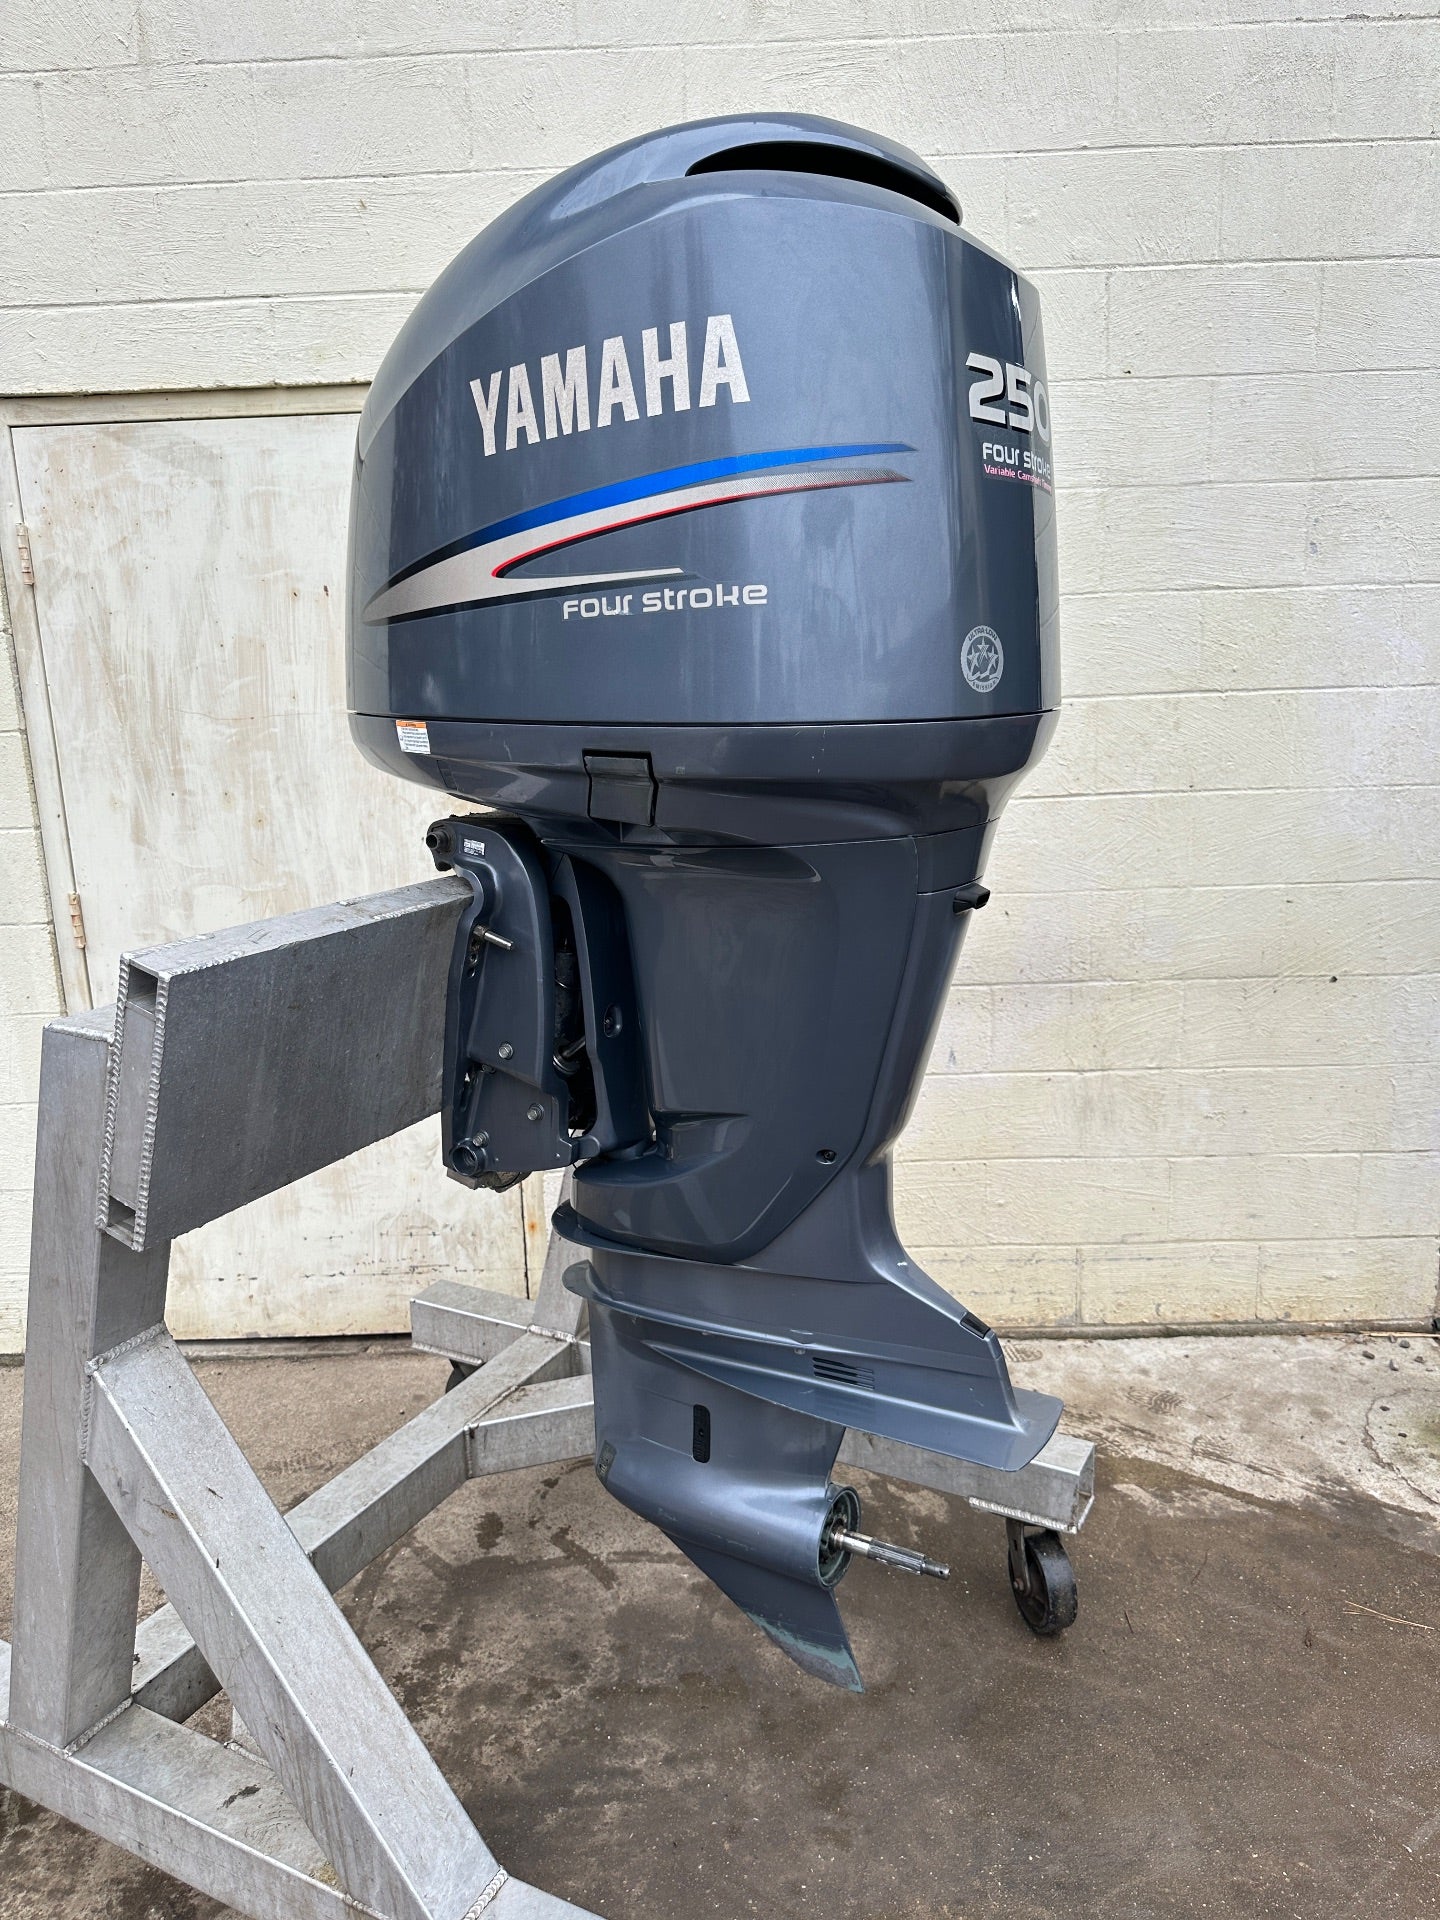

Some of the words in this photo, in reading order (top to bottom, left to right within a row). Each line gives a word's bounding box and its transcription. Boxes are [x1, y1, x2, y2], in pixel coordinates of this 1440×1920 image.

[469, 314, 751, 457] YAMAHA
[965, 352, 1049, 442] 250
[983, 463, 1016, 479] Variable
